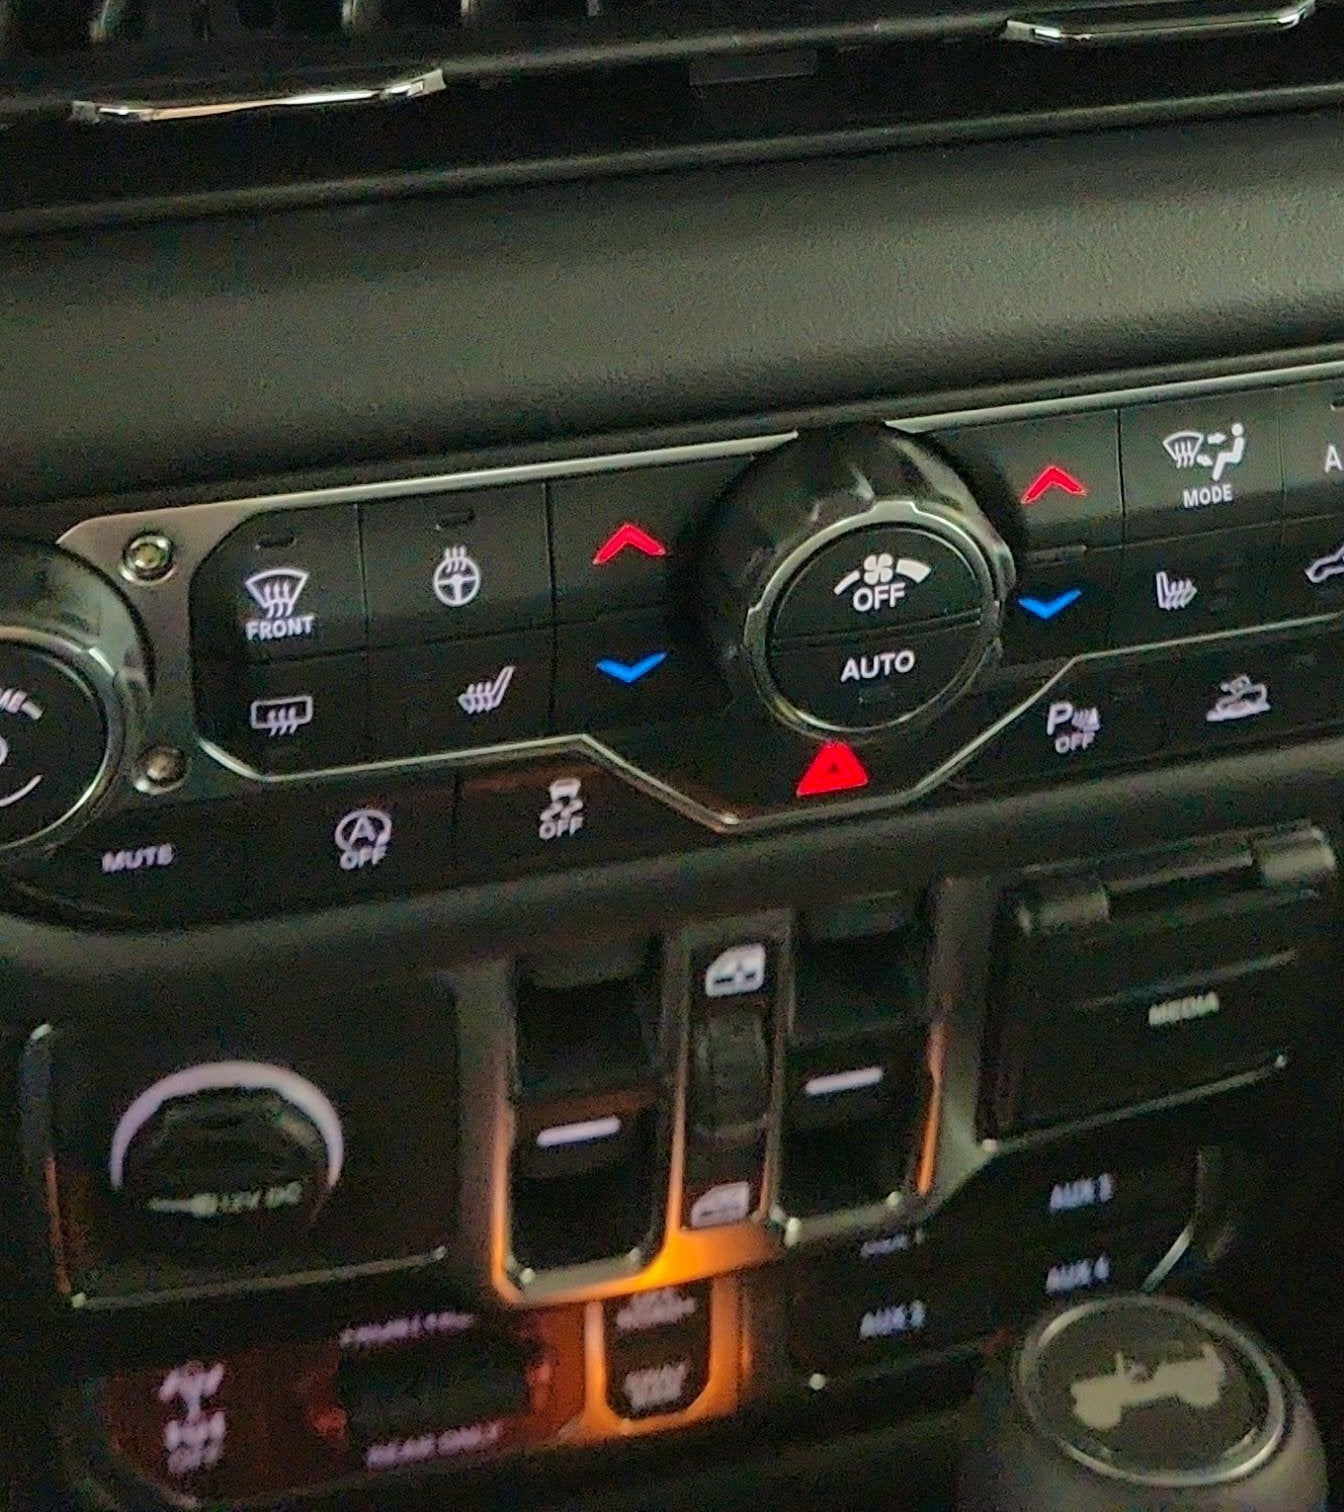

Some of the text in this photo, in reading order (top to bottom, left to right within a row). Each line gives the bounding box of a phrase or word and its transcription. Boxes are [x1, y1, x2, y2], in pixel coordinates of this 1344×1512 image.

[1183, 484, 1233, 509] MODE
[853, 583, 906, 612] OFF
[245, 612, 315, 642] FRONT
[840, 649, 916, 684] AUTO
[1055, 732, 1095, 755] OFF
[540, 815, 584, 840] OFF
[101, 843, 176, 873] MUTE
[340, 845, 387, 871] OFF
